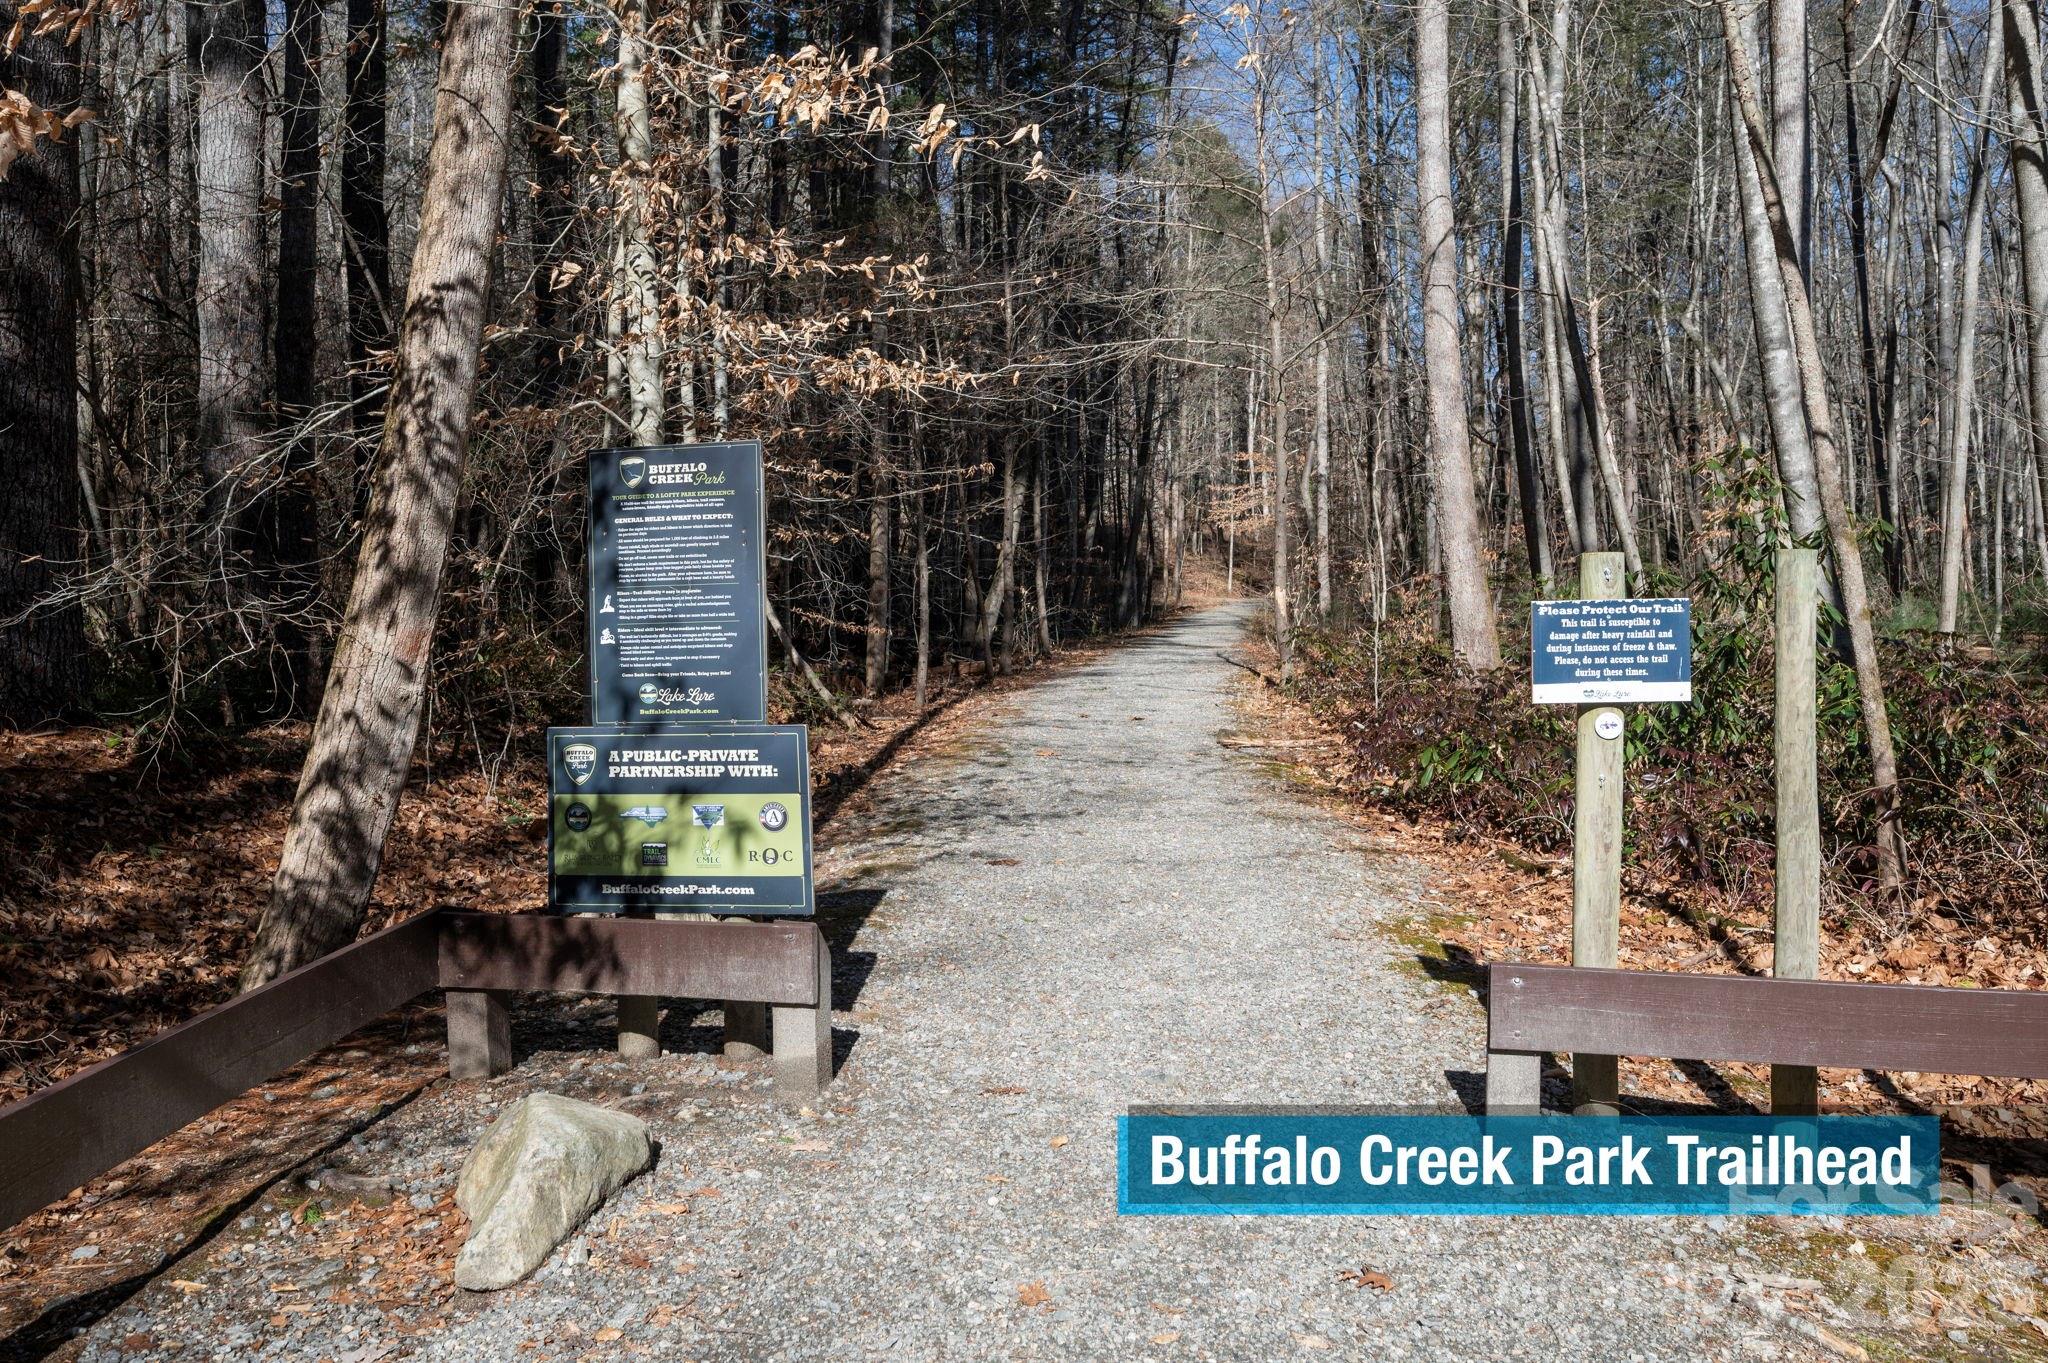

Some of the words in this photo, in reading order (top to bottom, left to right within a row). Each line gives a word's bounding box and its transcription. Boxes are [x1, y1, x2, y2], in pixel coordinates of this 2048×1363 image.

[648, 463, 707, 474] BUFFALO
[648, 474, 693, 485] CREEK
[693, 471, 726, 486] Park
[1538, 606, 1580, 616] Please
[1582, 605, 1627, 615] Protect
[1629, 604, 1652, 614] Our
[1653, 604, 1684, 613] Trail
[1561, 618, 1578, 627] This
[1580, 618, 1597, 627] trail
[1599, 617, 1606, 627] is
[1608, 617, 1650, 629] susceptible
[1652, 617, 1661, 626] to
[1549, 631, 1580, 642] damage
[1581, 630, 1600, 639] after
[1602, 630, 1625, 641] heavy
[1626, 629, 1656, 639] rainfall
[1658, 629, 1673, 638] and
[1546, 644, 1572, 654] during
[1574, 643, 1610, 652] instances
[1612, 642, 1621, 651] of
[1622, 642, 1646, 651] freeze
[1648, 642, 1654, 651] &
[1656, 642, 1678, 651] thaw.
[1554, 656, 1581, 666] Please,
[1582, 655, 1592, 664] do
[1594, 655, 1608, 664] not
[1610, 656, 1635, 664] access
[1636, 654, 1649, 663] the
[1651, 654, 1669, 663] trail
[1575, 668, 1600, 678] during
[1603, 668, 1623, 676] these
[1625, 667, 1649, 676] times.
[657, 687, 686, 705] Lake
[686, 687, 715, 705] Lure
[609, 750, 620, 762] A
[622, 749, 759, 762] PUBLIC-PRIVATE
[609, 765, 725, 778] PARTNERSHIP
[727, 765, 779, 777] WITH:
[769, 811, 779, 822] A
[601, 884, 755, 895] BuffaloCreekPark.com
